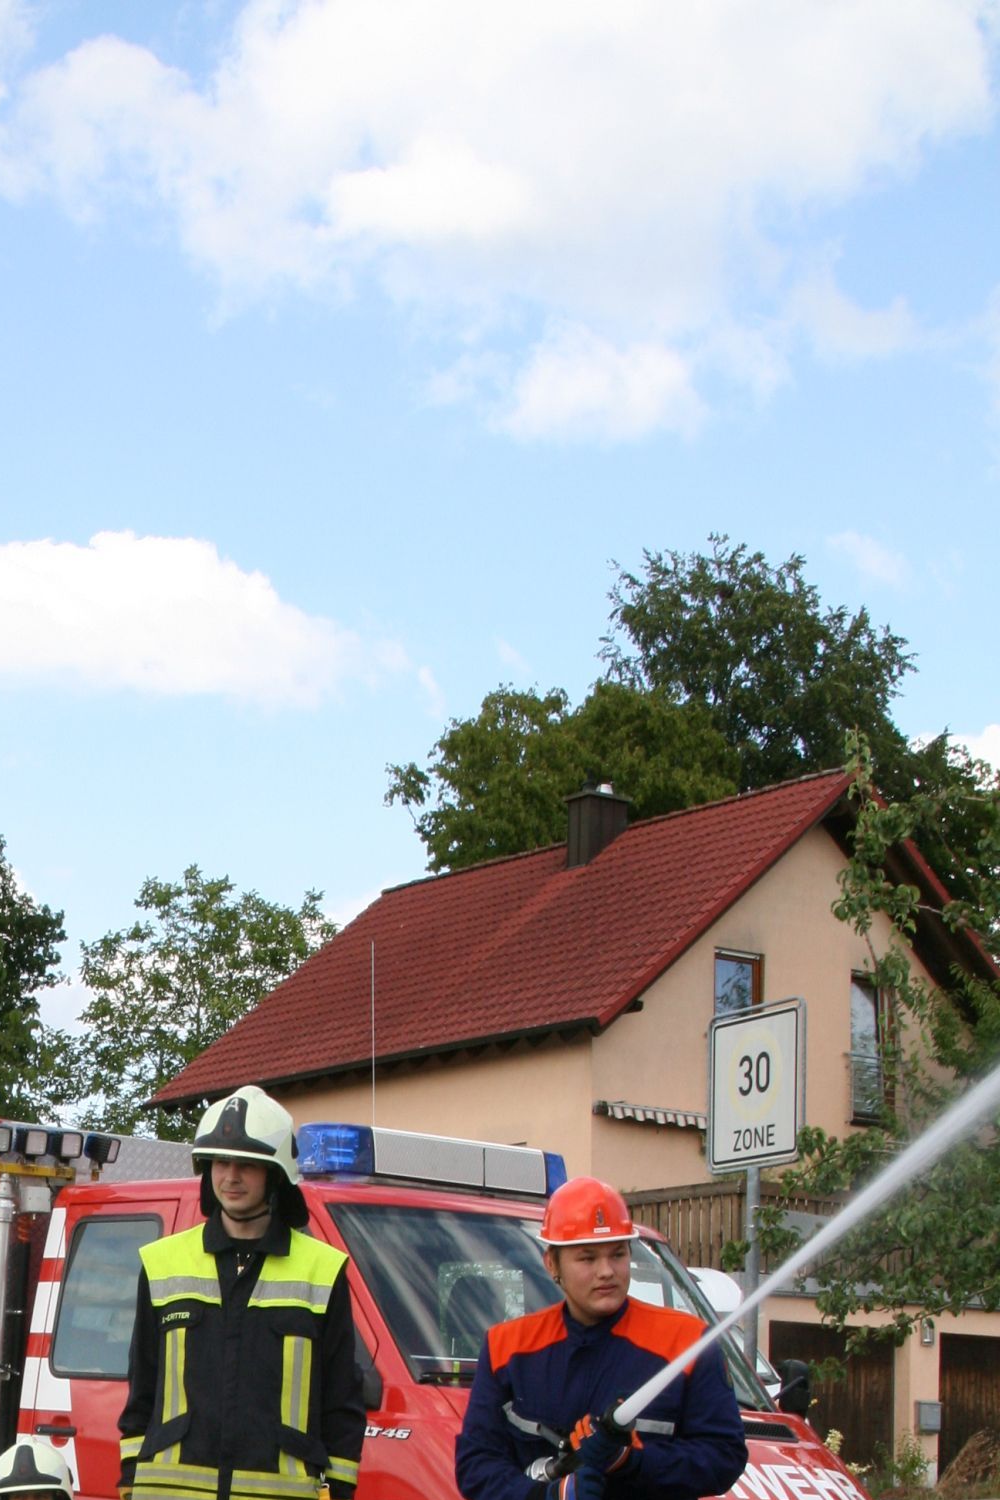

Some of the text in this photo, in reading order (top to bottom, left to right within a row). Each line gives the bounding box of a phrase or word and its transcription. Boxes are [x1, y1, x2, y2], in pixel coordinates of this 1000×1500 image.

[738, 1051, 770, 1096] 30
[225, 1098, 240, 1112] A
[733, 1124, 776, 1152] ZONE
